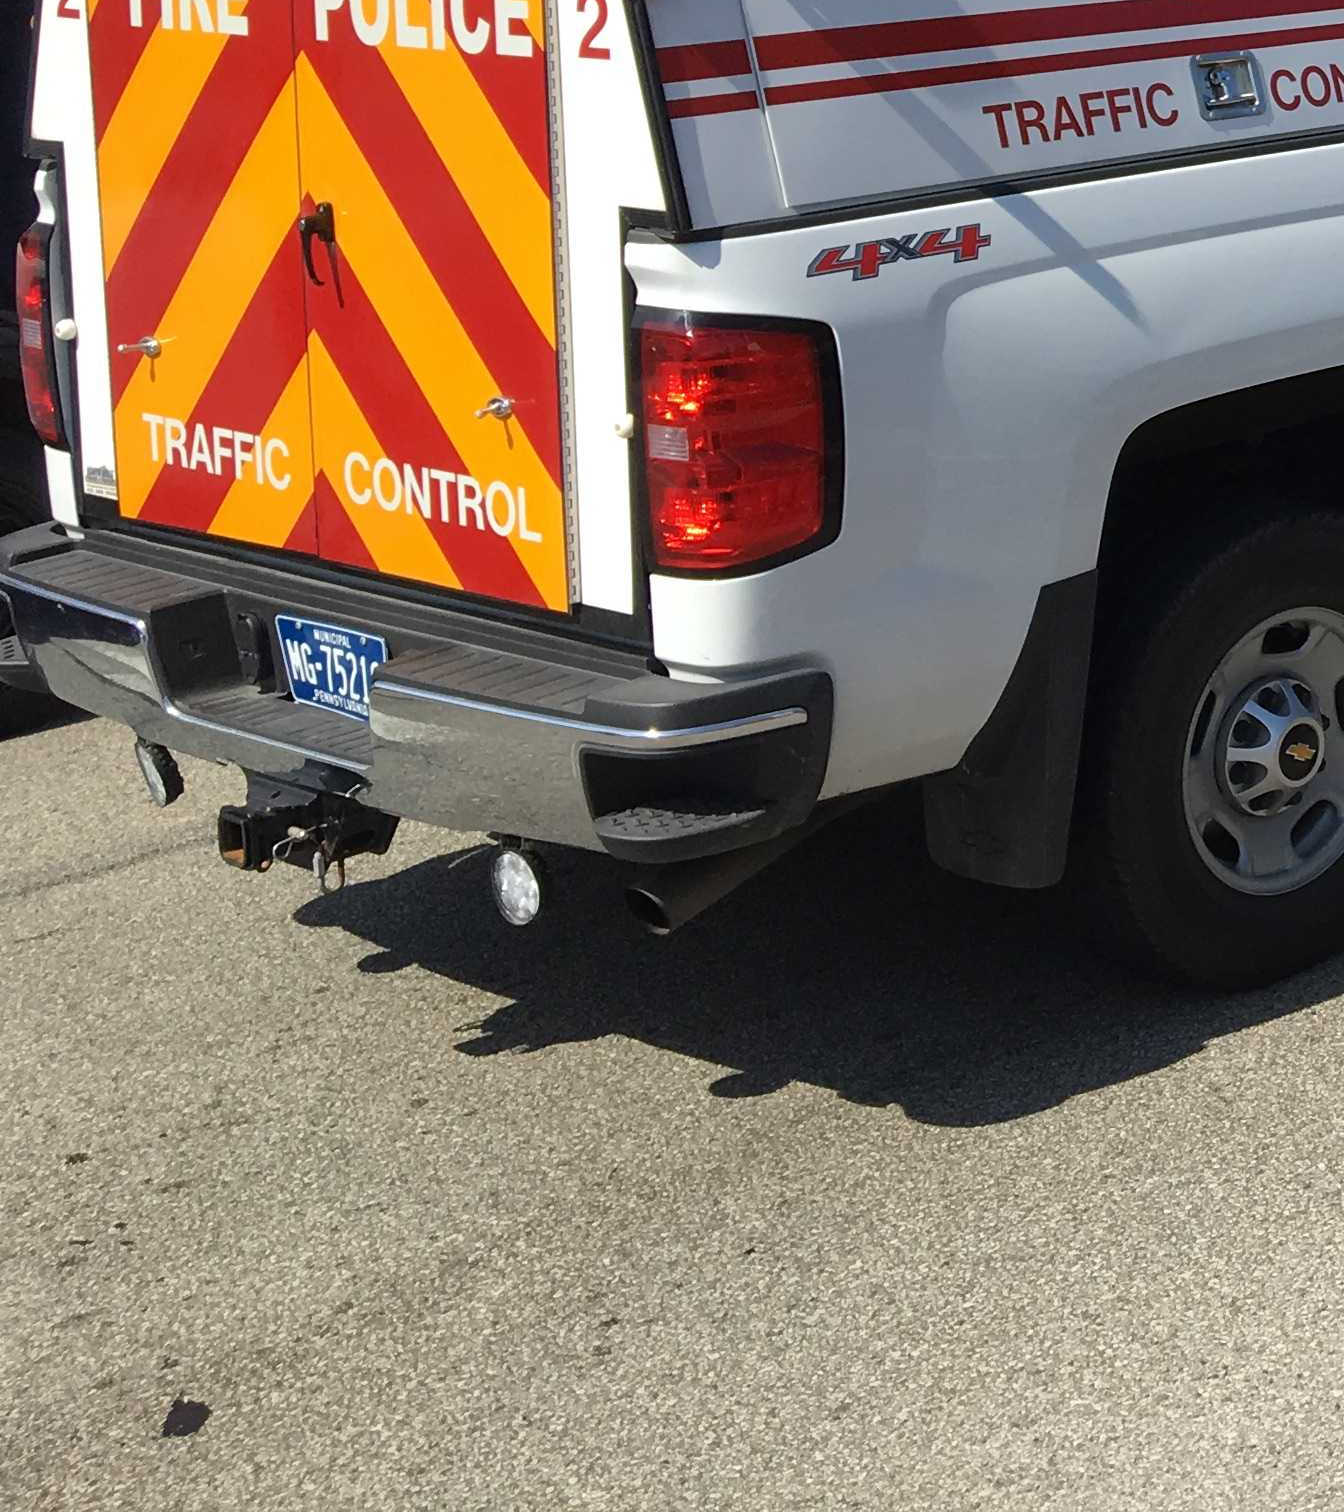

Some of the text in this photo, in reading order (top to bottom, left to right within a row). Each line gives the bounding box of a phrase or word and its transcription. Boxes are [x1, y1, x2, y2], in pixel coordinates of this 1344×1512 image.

[982, 82, 1179, 150] TRAFFIC
[142, 412, 543, 543] TRAFFIC CONTROL
[313, 629, 352, 649] MUNICIPAL
